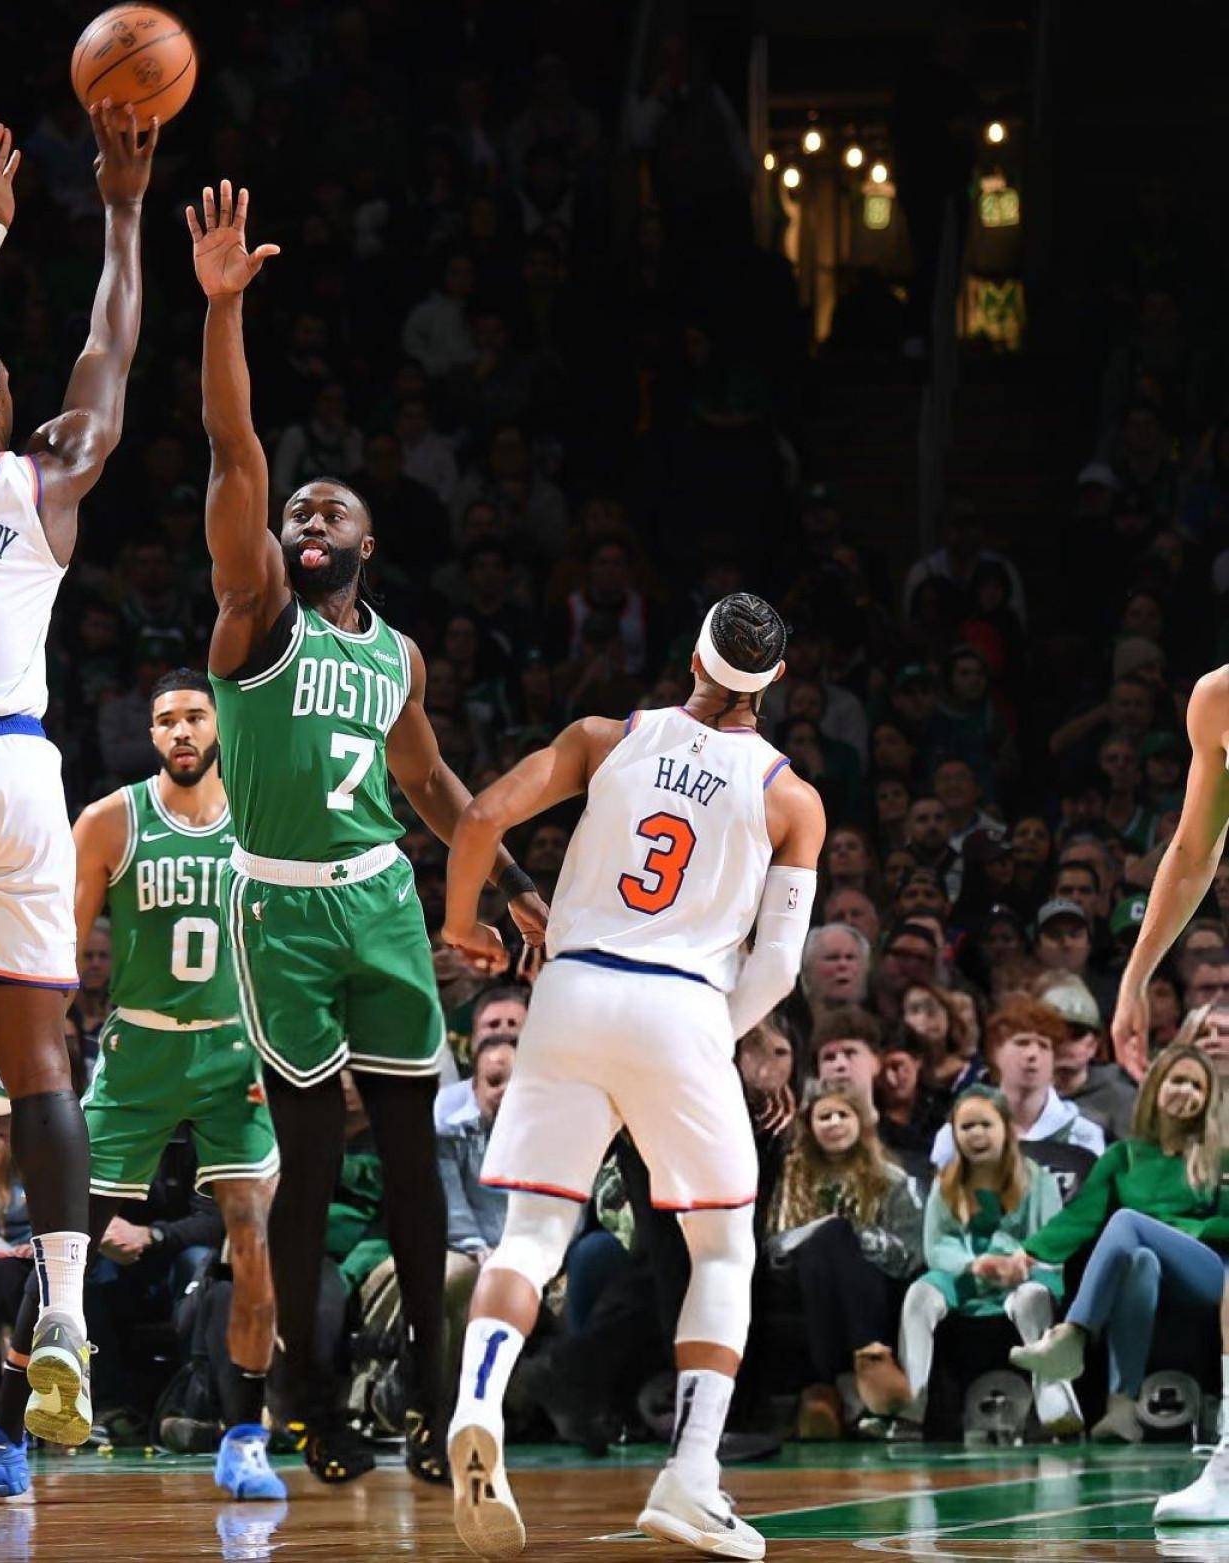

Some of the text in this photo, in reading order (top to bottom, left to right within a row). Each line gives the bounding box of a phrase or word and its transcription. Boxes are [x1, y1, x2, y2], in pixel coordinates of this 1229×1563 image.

[327, 732, 376, 811] 7
[654, 757, 727, 807] HART
[136, 856, 229, 912] BOST
[617, 811, 696, 916] 3
[171, 917, 219, 982] 0
